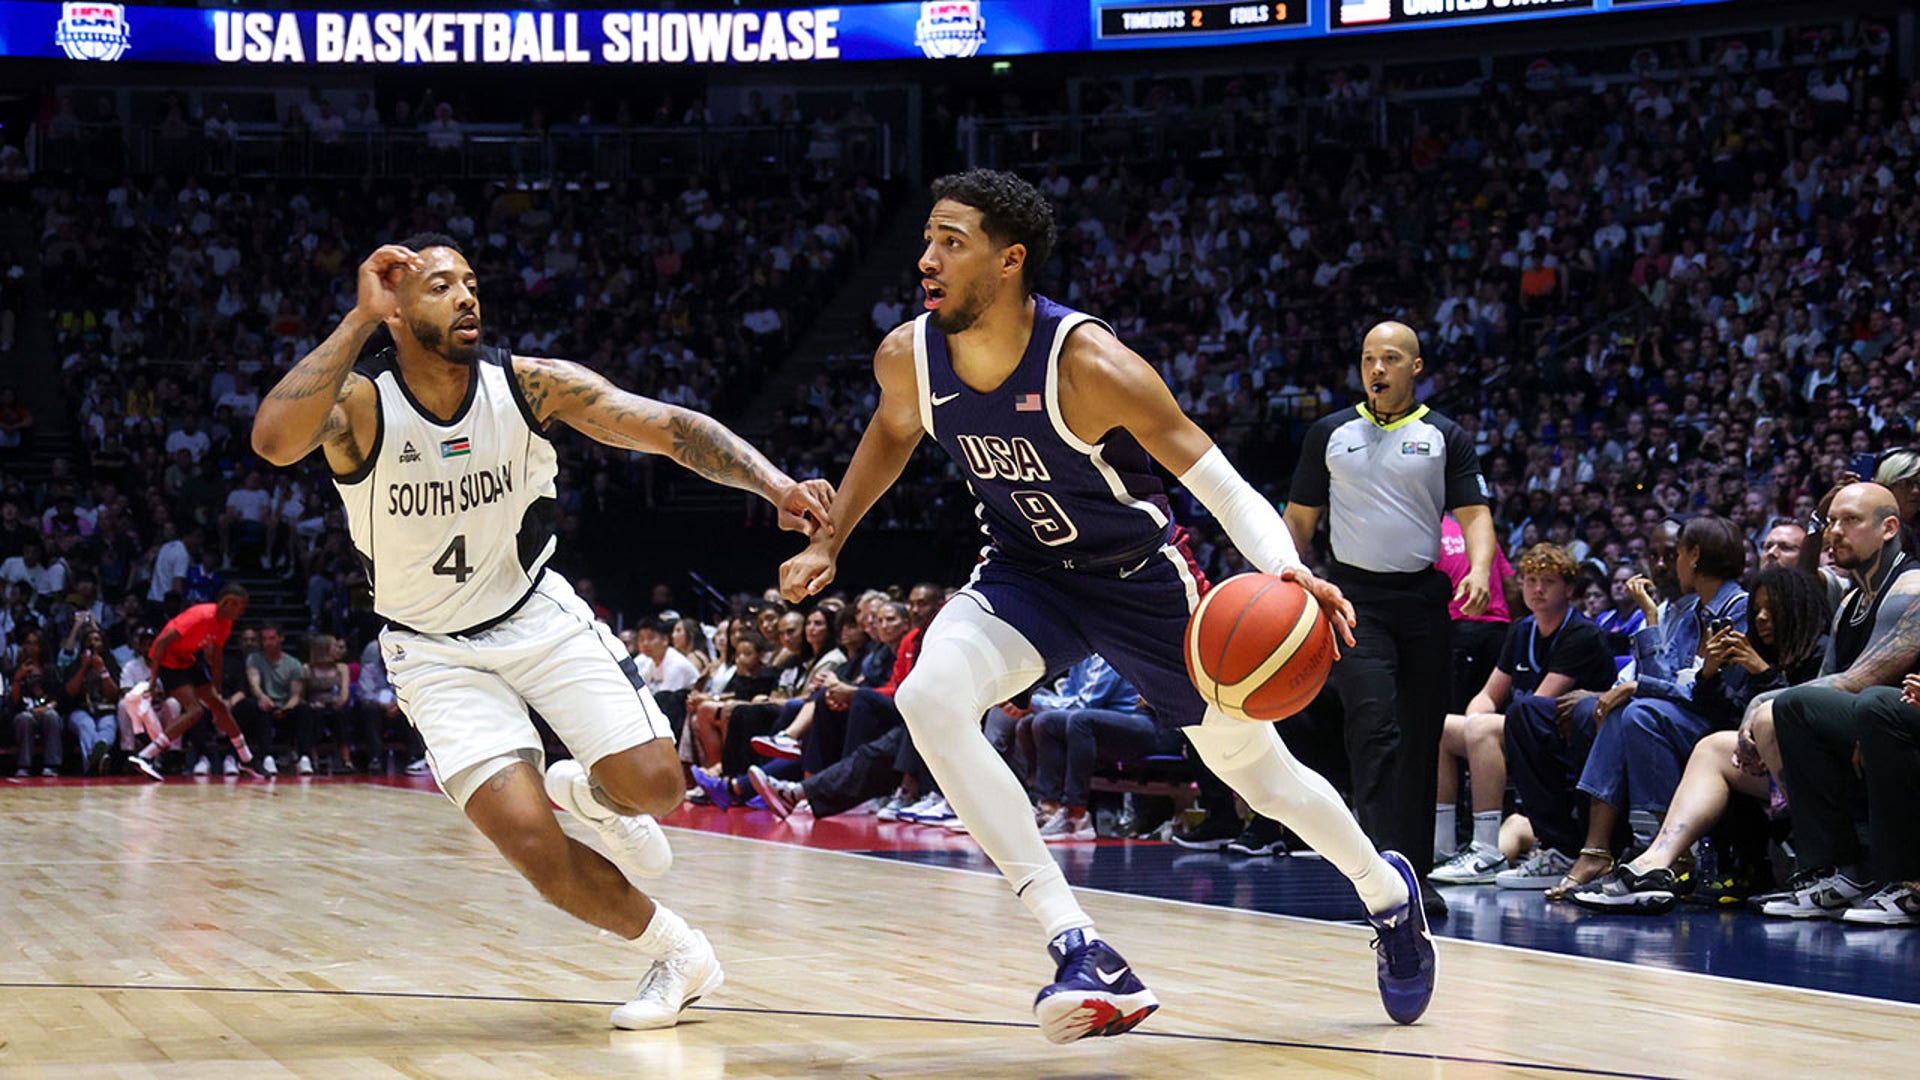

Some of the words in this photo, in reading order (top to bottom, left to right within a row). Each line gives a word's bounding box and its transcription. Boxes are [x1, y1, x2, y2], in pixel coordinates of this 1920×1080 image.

[214, 11, 305, 62] USA
[316, 13, 590, 62] BASKETBALL
[602, 9, 840, 62] SHOWCASE
[1122, 11, 1186, 30] TIMEOUTS
[1191, 9, 1203, 27] 2
[1230, 5, 1269, 25] FOULS
[1275, 2, 1287, 21] 3
[957, 435, 1051, 482] USA
[388, 481, 455, 516] SOUTH
[459, 460, 513, 512] SUDAN
[1011, 490, 1078, 546] 9
[432, 534, 474, 583] 4
